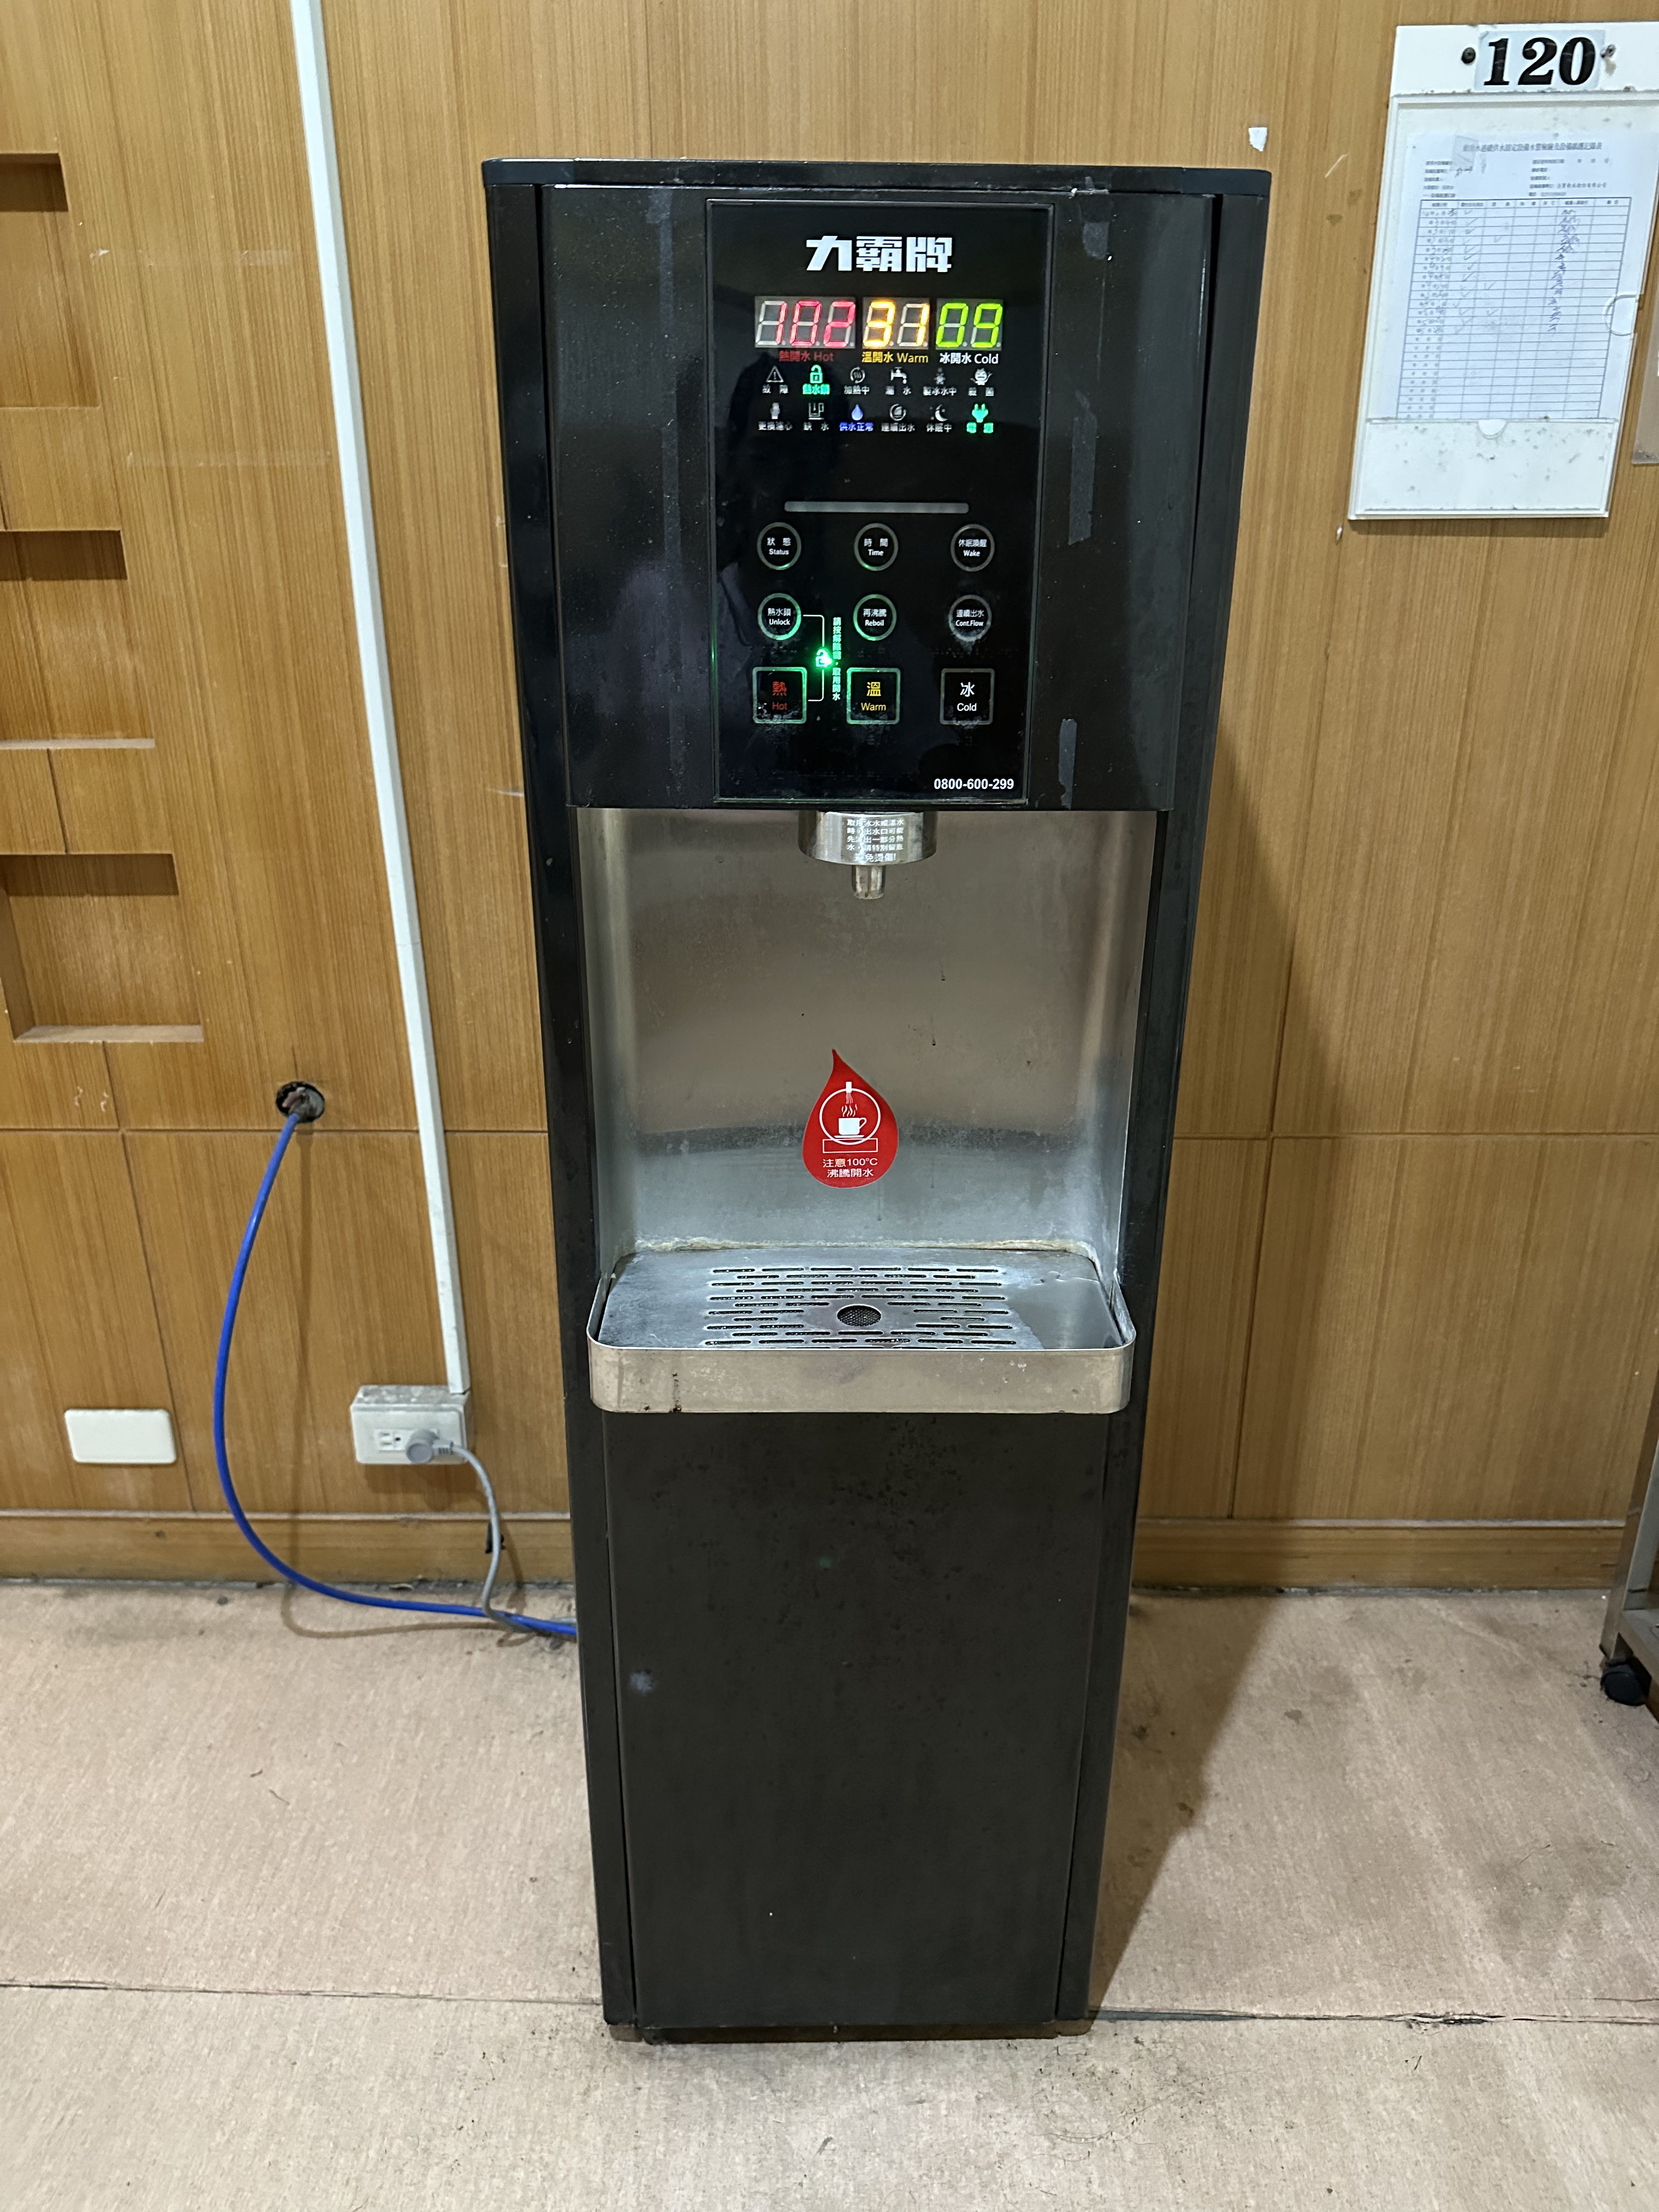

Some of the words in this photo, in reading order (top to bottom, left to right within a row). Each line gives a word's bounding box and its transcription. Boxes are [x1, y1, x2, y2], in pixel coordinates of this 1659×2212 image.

[1483, 37, 1596, 86] 120
[806, 235, 953, 273] 力霸牌
[775, 300, 856, 347] 102
[863, 301, 930, 347] 31
[935, 302, 1003, 347] 09
[779, 351, 811, 362] 熱開水
[814, 352, 834, 362] Hot
[897, 353, 929, 363] Warm
[939, 352, 972, 364] 冰開水
[974, 354, 999, 364] Cold
[843, 385, 870, 395] 加熱中
[839, 422, 873, 431] 供水正常
[881, 422, 916, 432] 連續出水
[926, 423, 952, 432] 休眠中
[767, 537, 791, 546] 狀態
[864, 538, 888, 547] 時間
[958, 539, 987, 548] 休眠喚醒
[863, 608, 887, 617] 再沸騰
[956, 609, 985, 618] 連續出水
[772, 681, 787, 696] 熱
[866, 681, 882, 697] 溫
[960, 681, 975, 697] 冰
[772, 702, 788, 710] Hot
[861, 703, 887, 712] Warm
[957, 703, 977, 712] Cold
[934, 778, 1014, 790] 0800-600-299
[827, 1168, 874, 1178] 沸騰開水
